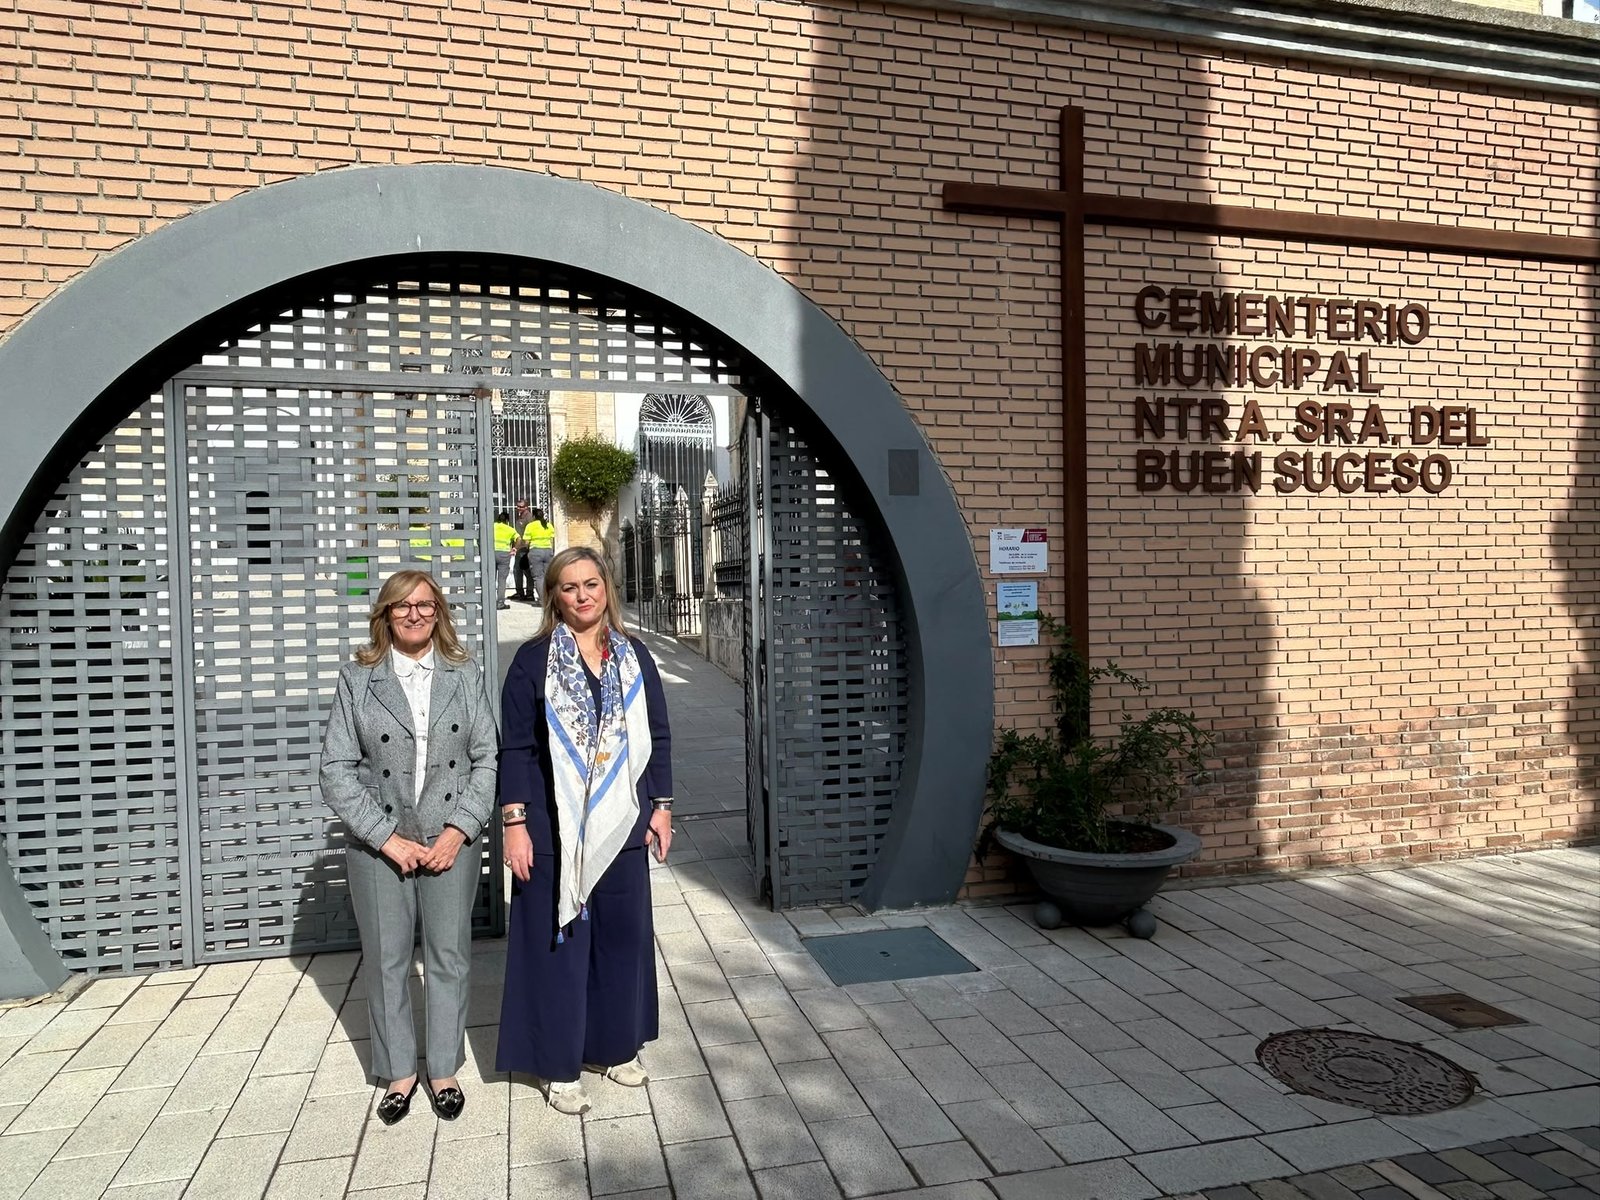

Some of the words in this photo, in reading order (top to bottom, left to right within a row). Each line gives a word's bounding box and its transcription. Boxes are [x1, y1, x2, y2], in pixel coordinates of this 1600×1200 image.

[1135, 285, 1430, 345] CEMENTERIO
[1134, 342, 1384, 393] MUNICIPAL
[1135, 396, 1282, 442] NTRA.
[1295, 399, 1400, 445] SRA.
[1410, 405, 1491, 446] DEL
[1136, 449, 1262, 493] BUEN
[1274, 451, 1452, 494] SUCESO
